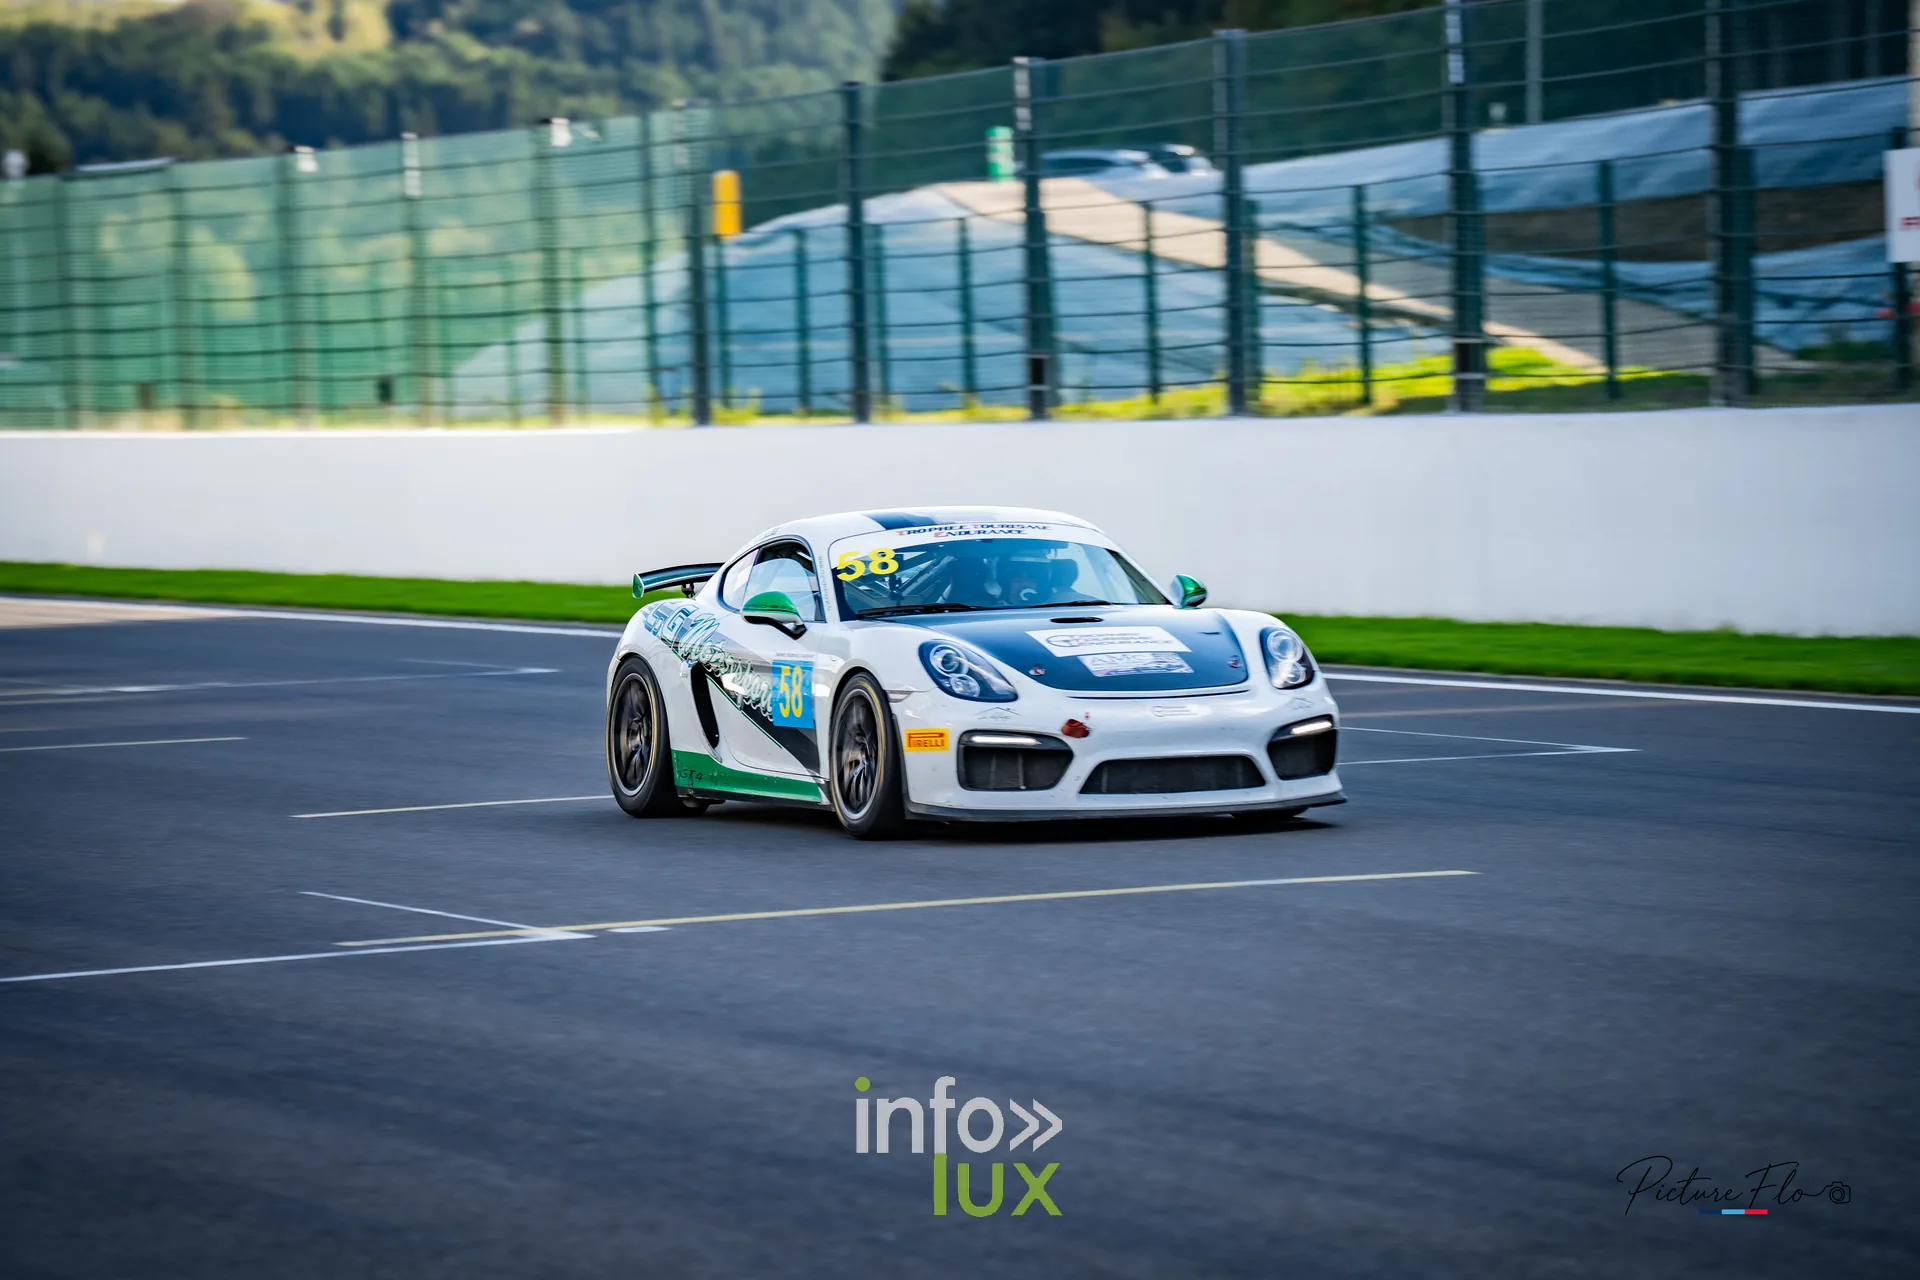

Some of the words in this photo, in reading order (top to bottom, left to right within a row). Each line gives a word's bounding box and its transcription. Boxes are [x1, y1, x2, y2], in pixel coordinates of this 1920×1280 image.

[933, 529, 1028, 538] ENDURANCE
[973, 523, 1053, 531] TOURISME
[836, 547, 899, 581] 58
[779, 665, 803, 718] 58
[907, 731, 945, 748] PIRELLI
